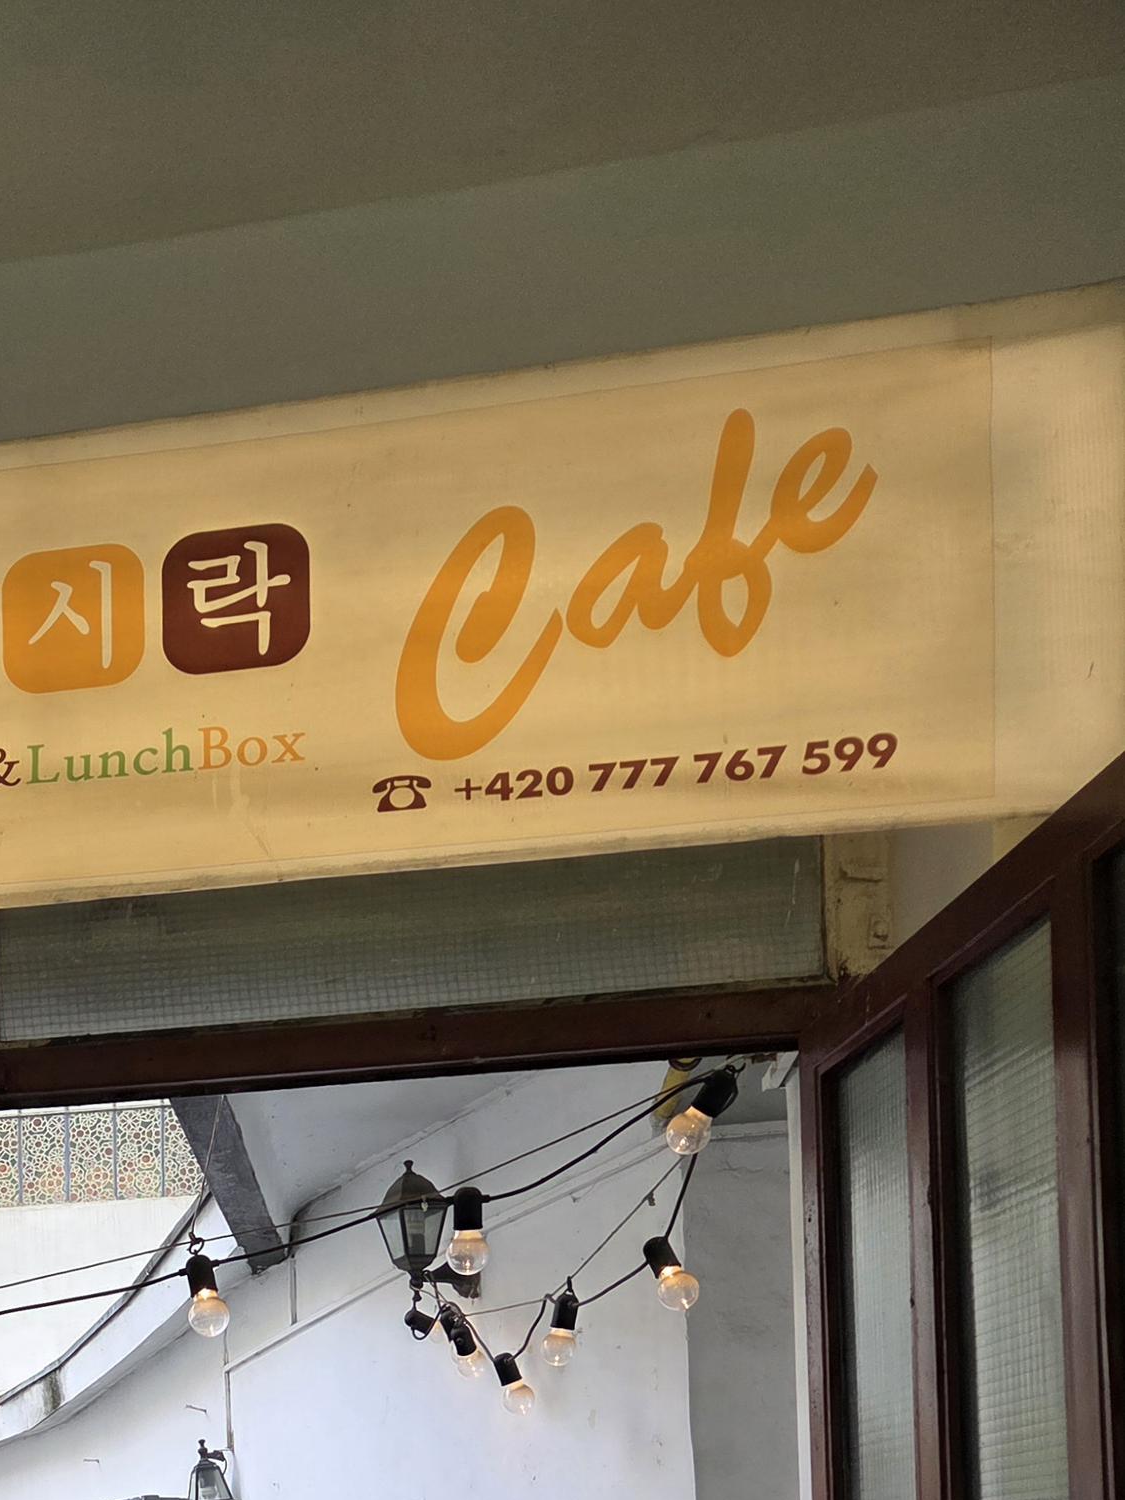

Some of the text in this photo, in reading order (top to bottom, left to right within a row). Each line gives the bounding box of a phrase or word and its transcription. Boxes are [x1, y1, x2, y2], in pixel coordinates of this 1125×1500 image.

[395, 408, 878, 761] Cafe
[454, 733, 898, 801] +420 777 767 599
